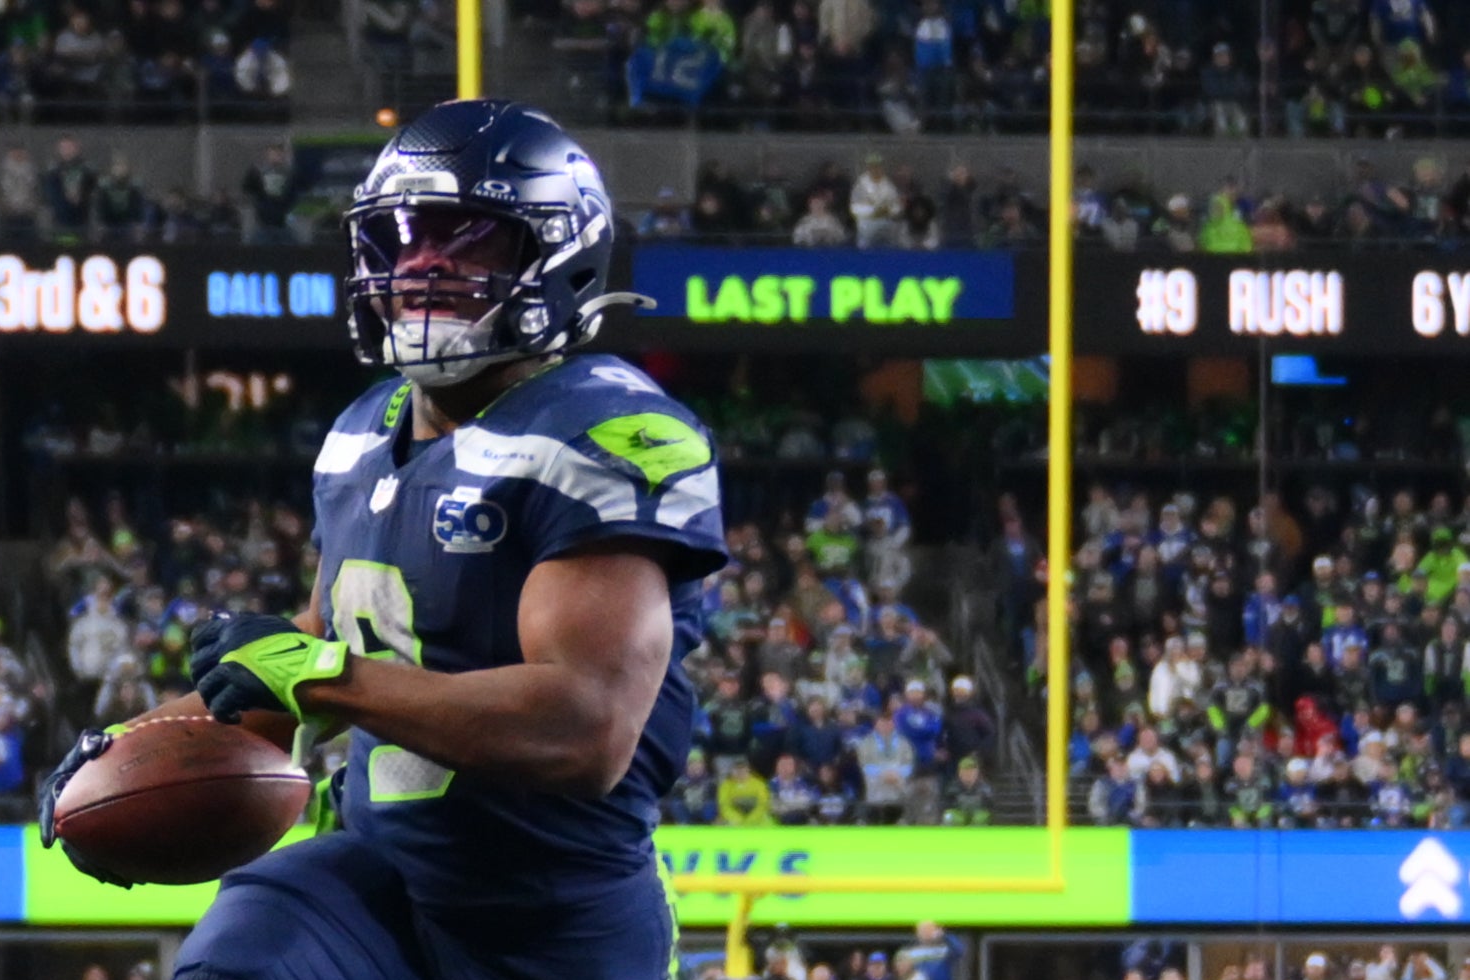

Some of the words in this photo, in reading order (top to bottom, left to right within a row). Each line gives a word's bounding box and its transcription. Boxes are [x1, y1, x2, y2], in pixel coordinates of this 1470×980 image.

[207, 271, 282, 317] BALL
[289, 272, 335, 317] ON
[686, 275, 814, 323] LAST
[829, 275, 962, 324] PLAY
[1136, 268, 1197, 336] #9
[1228, 268, 1344, 336] RUSH
